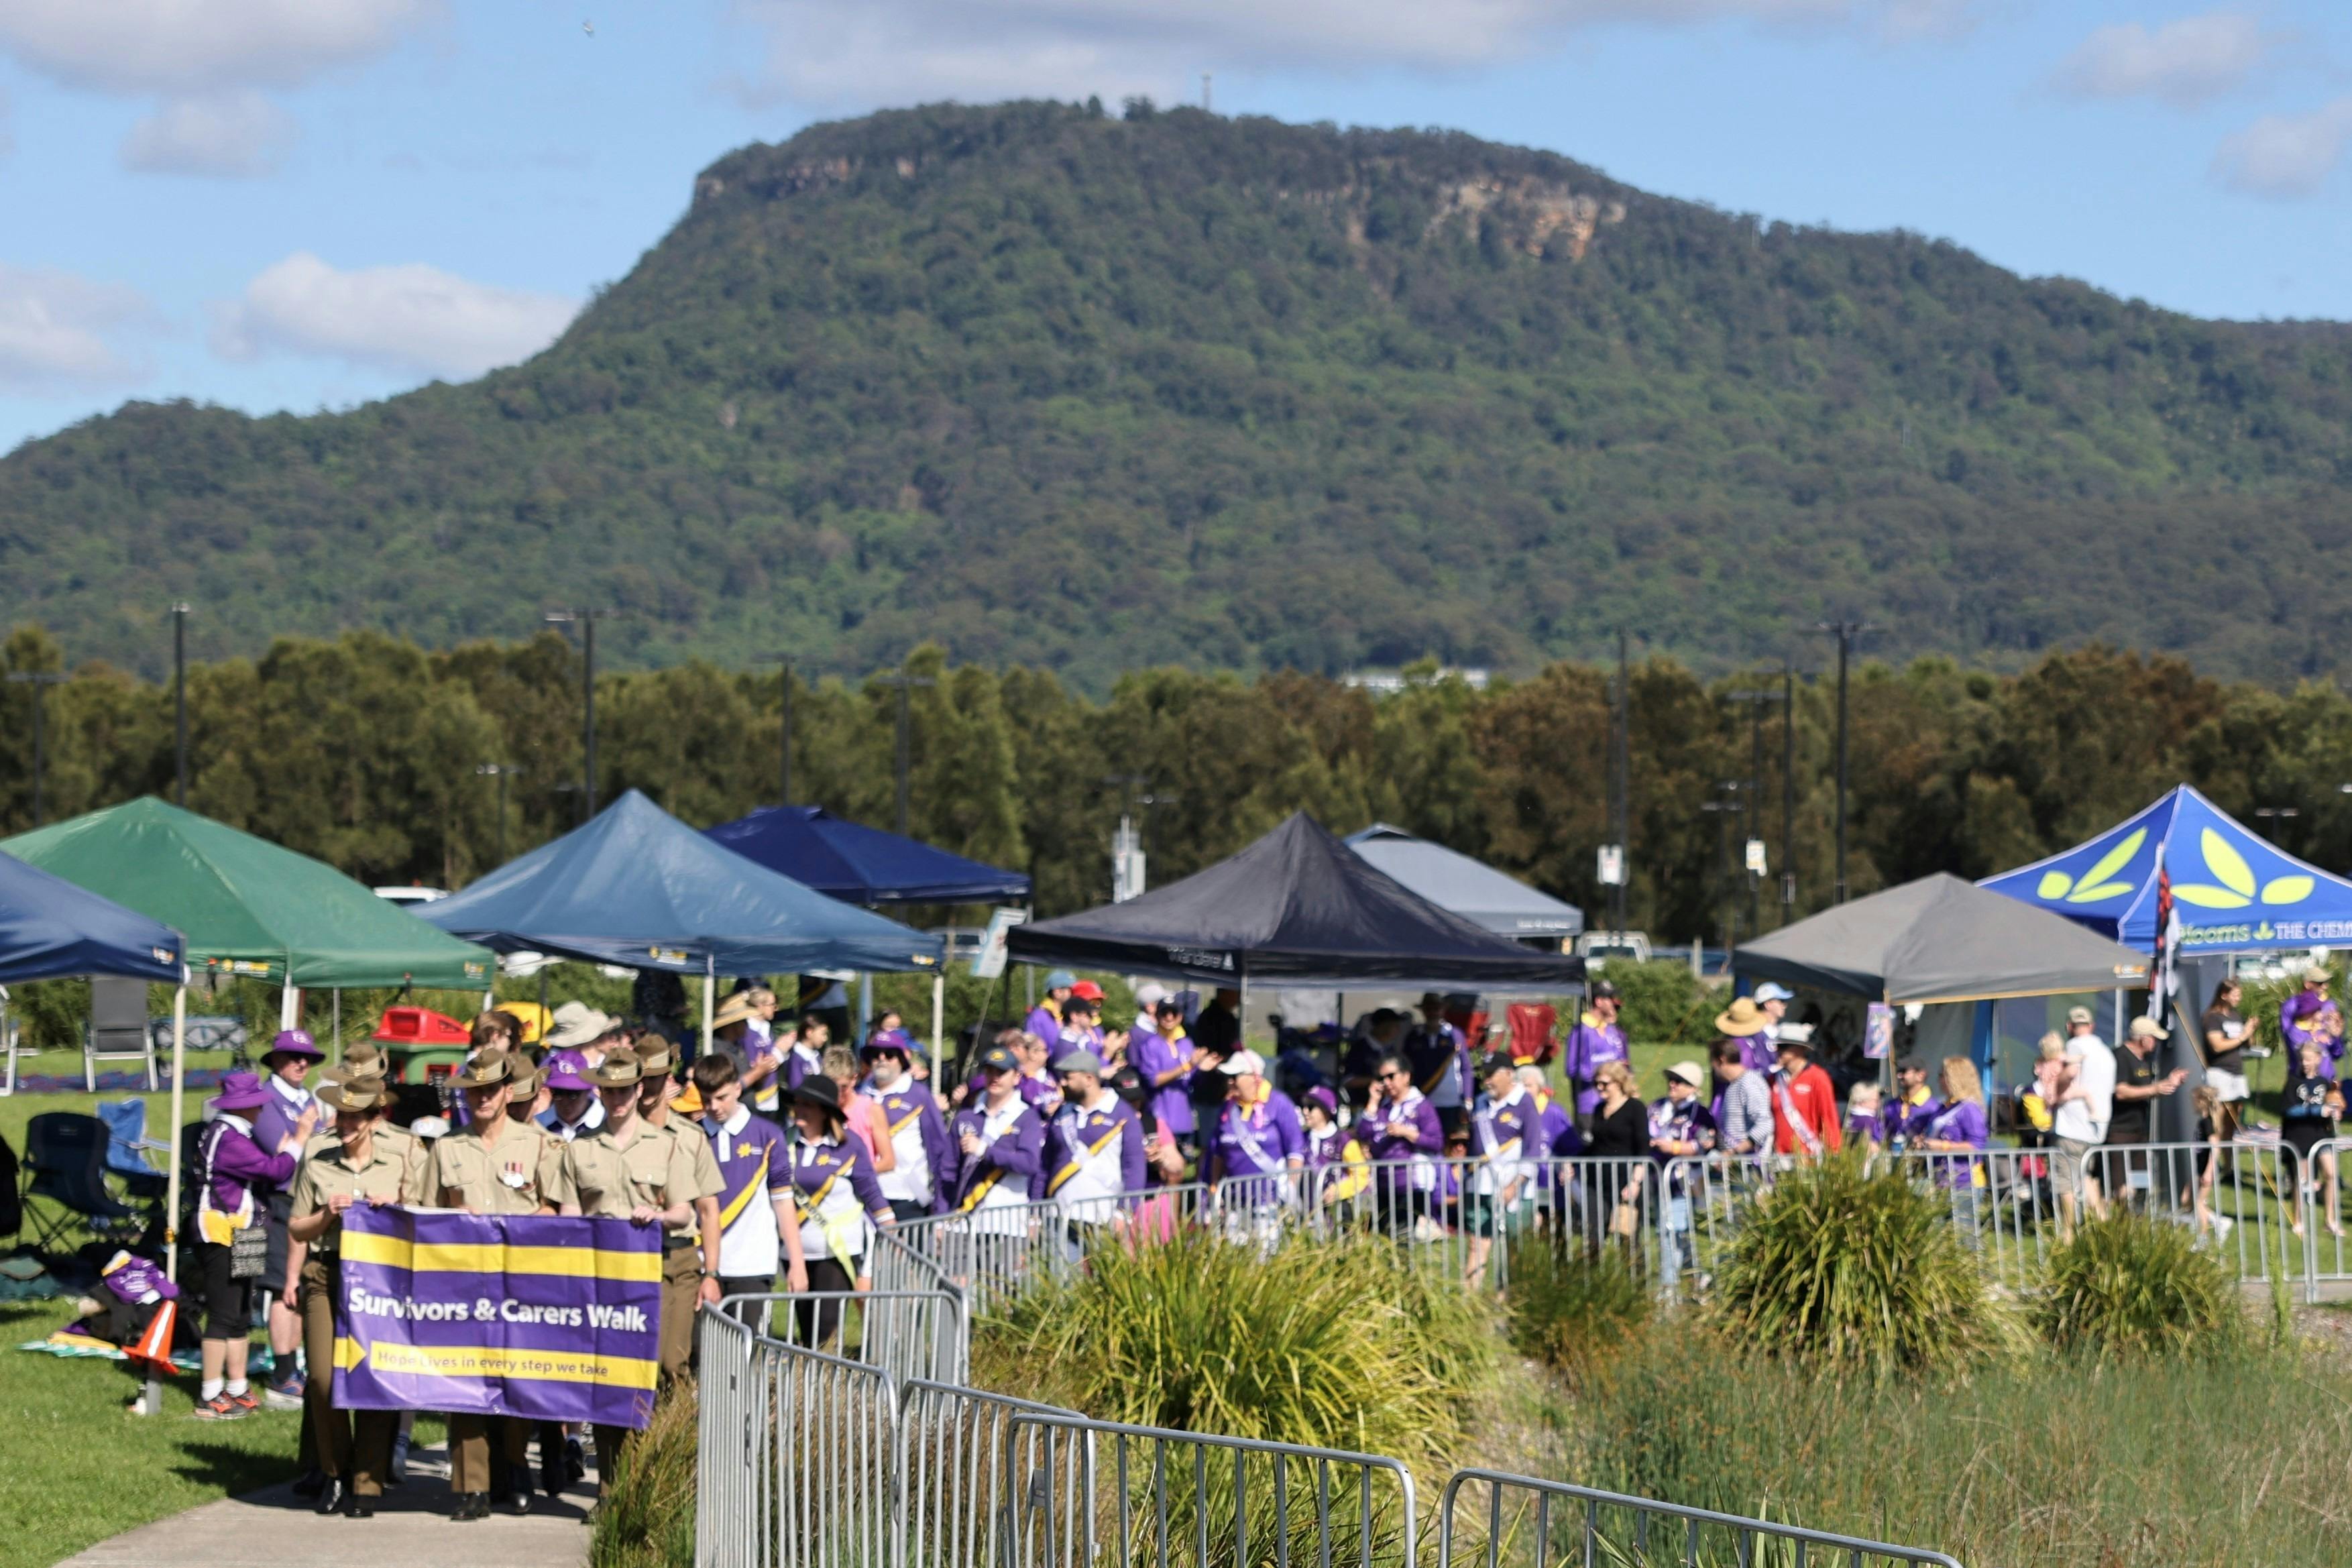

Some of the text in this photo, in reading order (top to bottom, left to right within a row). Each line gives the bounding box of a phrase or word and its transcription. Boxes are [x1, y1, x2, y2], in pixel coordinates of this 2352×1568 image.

[2274, 921, 2306, 940] THE
[348, 1286, 648, 1333] Survivors & Carers Walk
[378, 1351, 609, 1377] Hope Lives in every step we take
